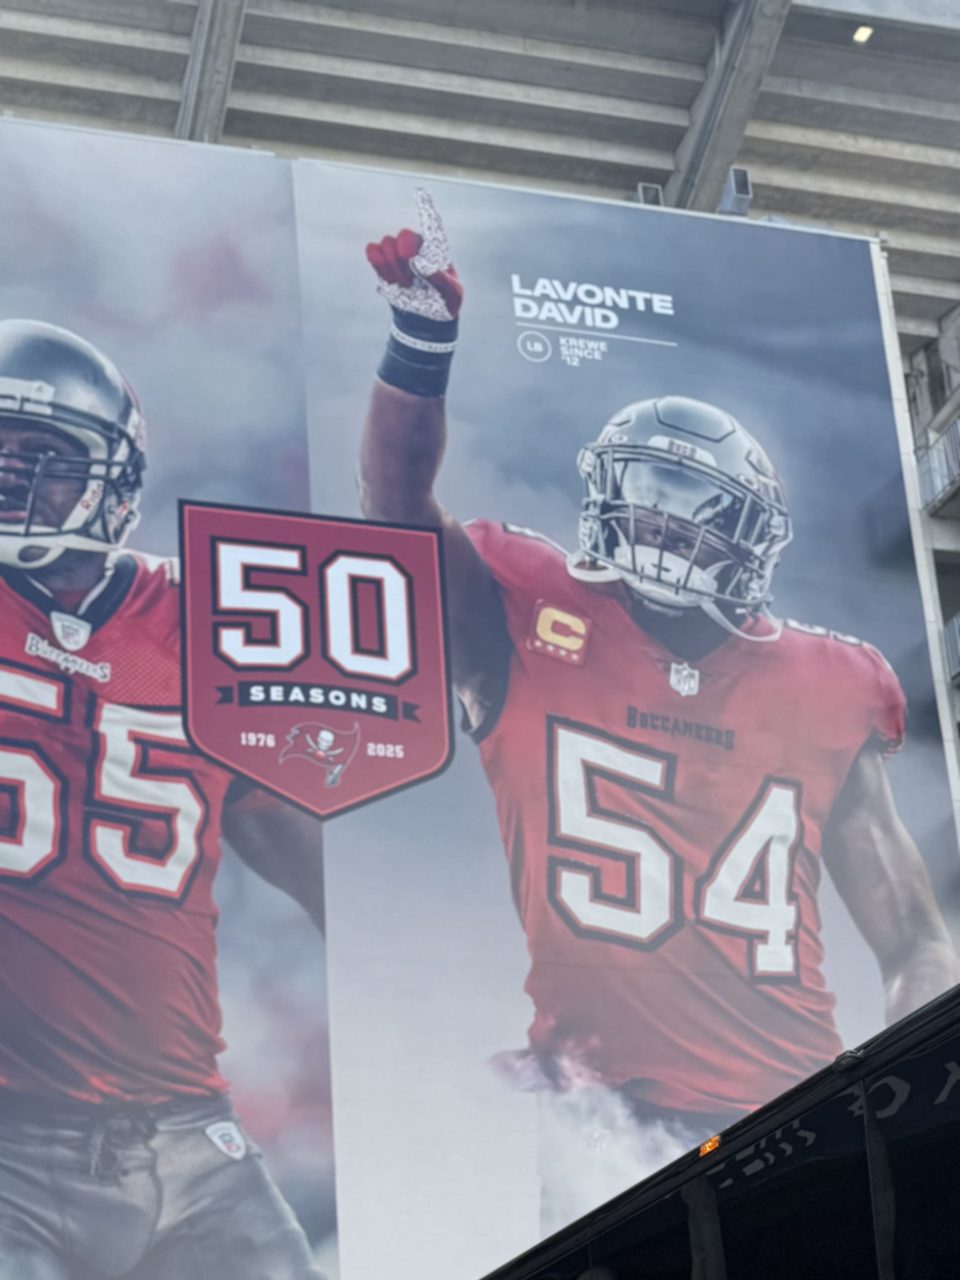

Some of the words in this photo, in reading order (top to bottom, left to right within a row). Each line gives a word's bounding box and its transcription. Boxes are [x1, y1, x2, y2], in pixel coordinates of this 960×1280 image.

[511, 274, 674, 315] LAVONTE
[513, 297, 619, 329] DAVID
[526, 341, 543, 352] LB
[559, 336, 607, 351] KREWE
[560, 346, 602, 360] SINCE
[213, 538, 416, 685] 50
[249, 685, 388, 712] SEASONS
[240, 732, 276, 748] 1976
[367, 742, 404, 758] 2025
[549, 717, 802, 981] 54
